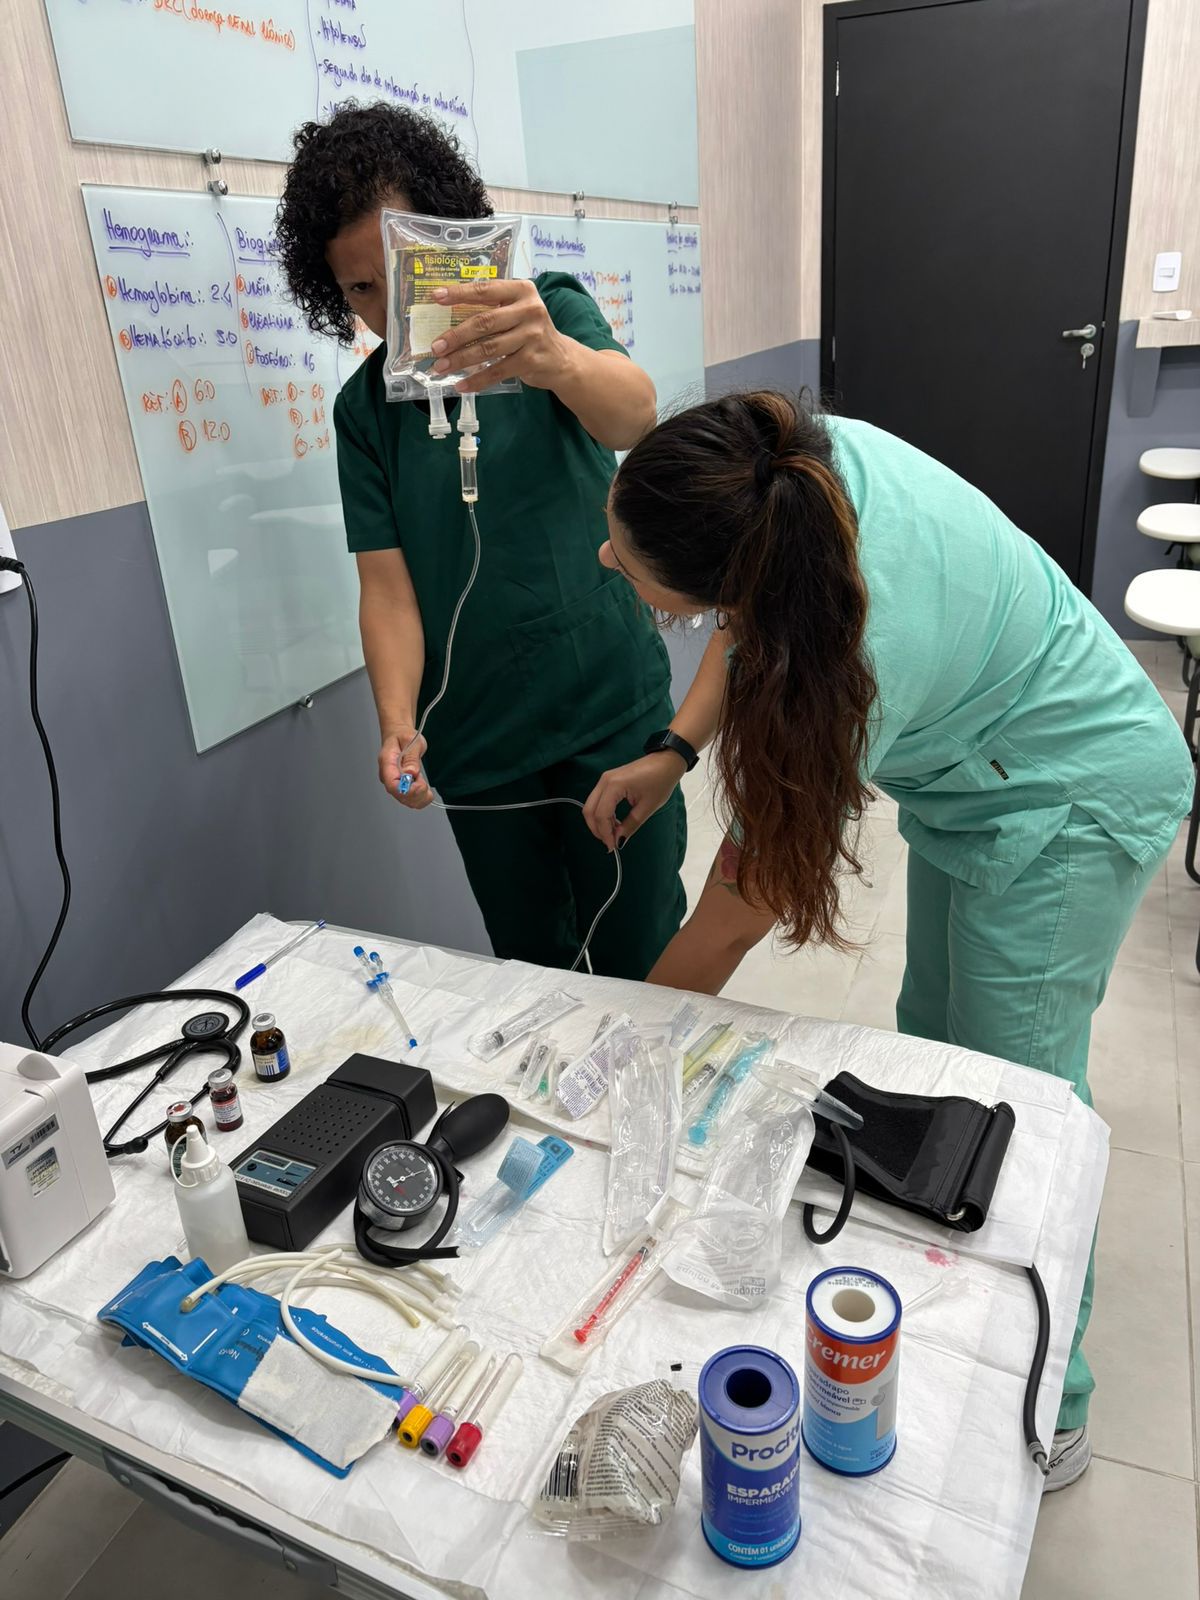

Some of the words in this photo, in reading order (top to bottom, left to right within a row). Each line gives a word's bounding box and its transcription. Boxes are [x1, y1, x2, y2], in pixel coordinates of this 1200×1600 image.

[425, 254, 470, 267] fisiológico
[807, 1325, 887, 1370] Cremer
[731, 1421, 800, 1461] Procit
[726, 1460, 800, 1498] ESPARAD
[728, 1543, 759, 1555] CONTÉM
